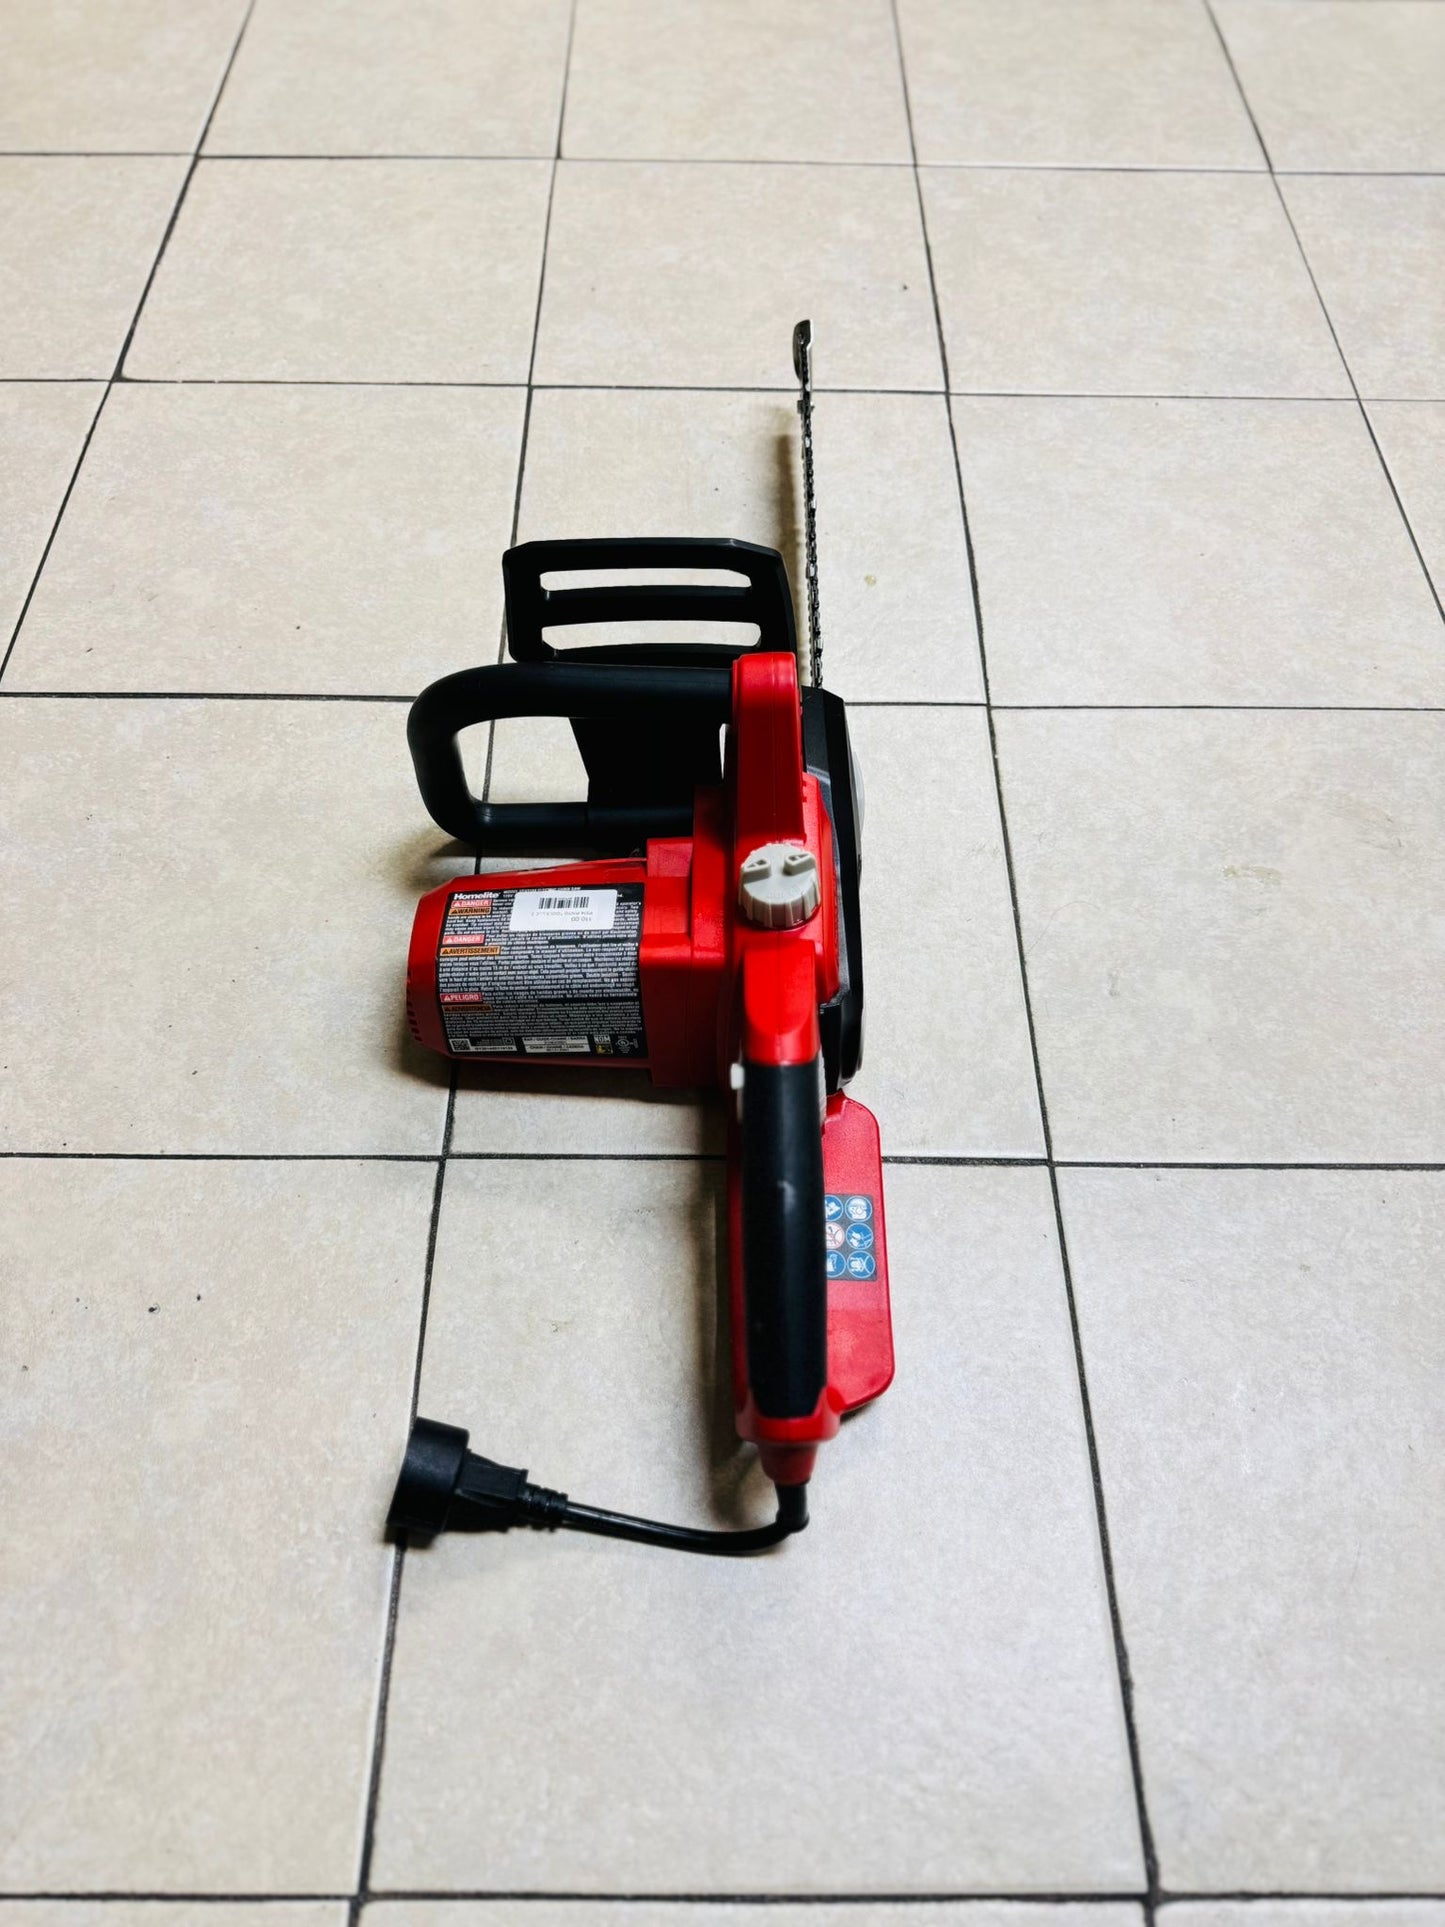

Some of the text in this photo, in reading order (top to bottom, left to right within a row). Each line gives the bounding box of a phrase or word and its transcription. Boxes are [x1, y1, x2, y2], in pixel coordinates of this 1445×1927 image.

[454, 892, 499, 900] Homelite
[458, 907, 490, 915] WARNING
[453, 935, 480, 943] DANGER
[449, 946, 499, 955] AVERTISSEMENT
